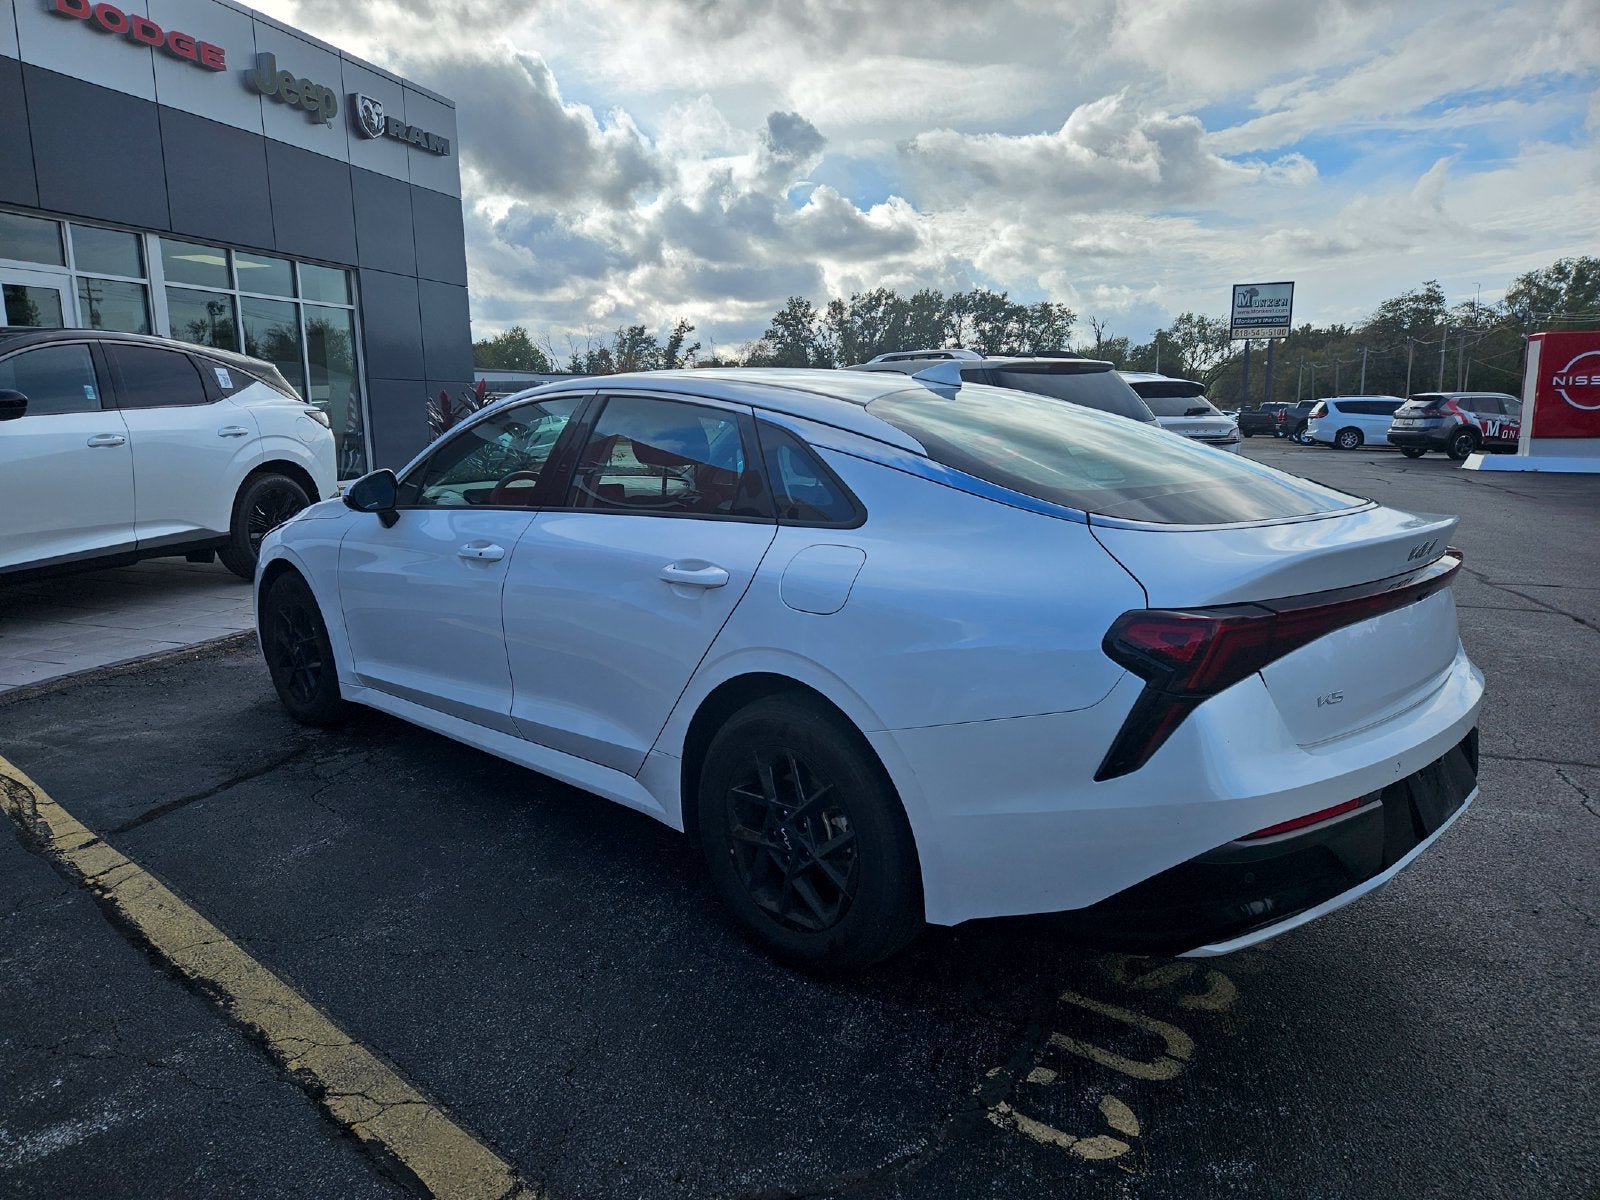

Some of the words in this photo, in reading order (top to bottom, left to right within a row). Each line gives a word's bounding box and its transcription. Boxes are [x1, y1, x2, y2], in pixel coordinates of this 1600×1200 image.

[249, 52, 338, 125] Jeep
[385, 115, 451, 157] RAM
[1316, 690, 1344, 708] K5
